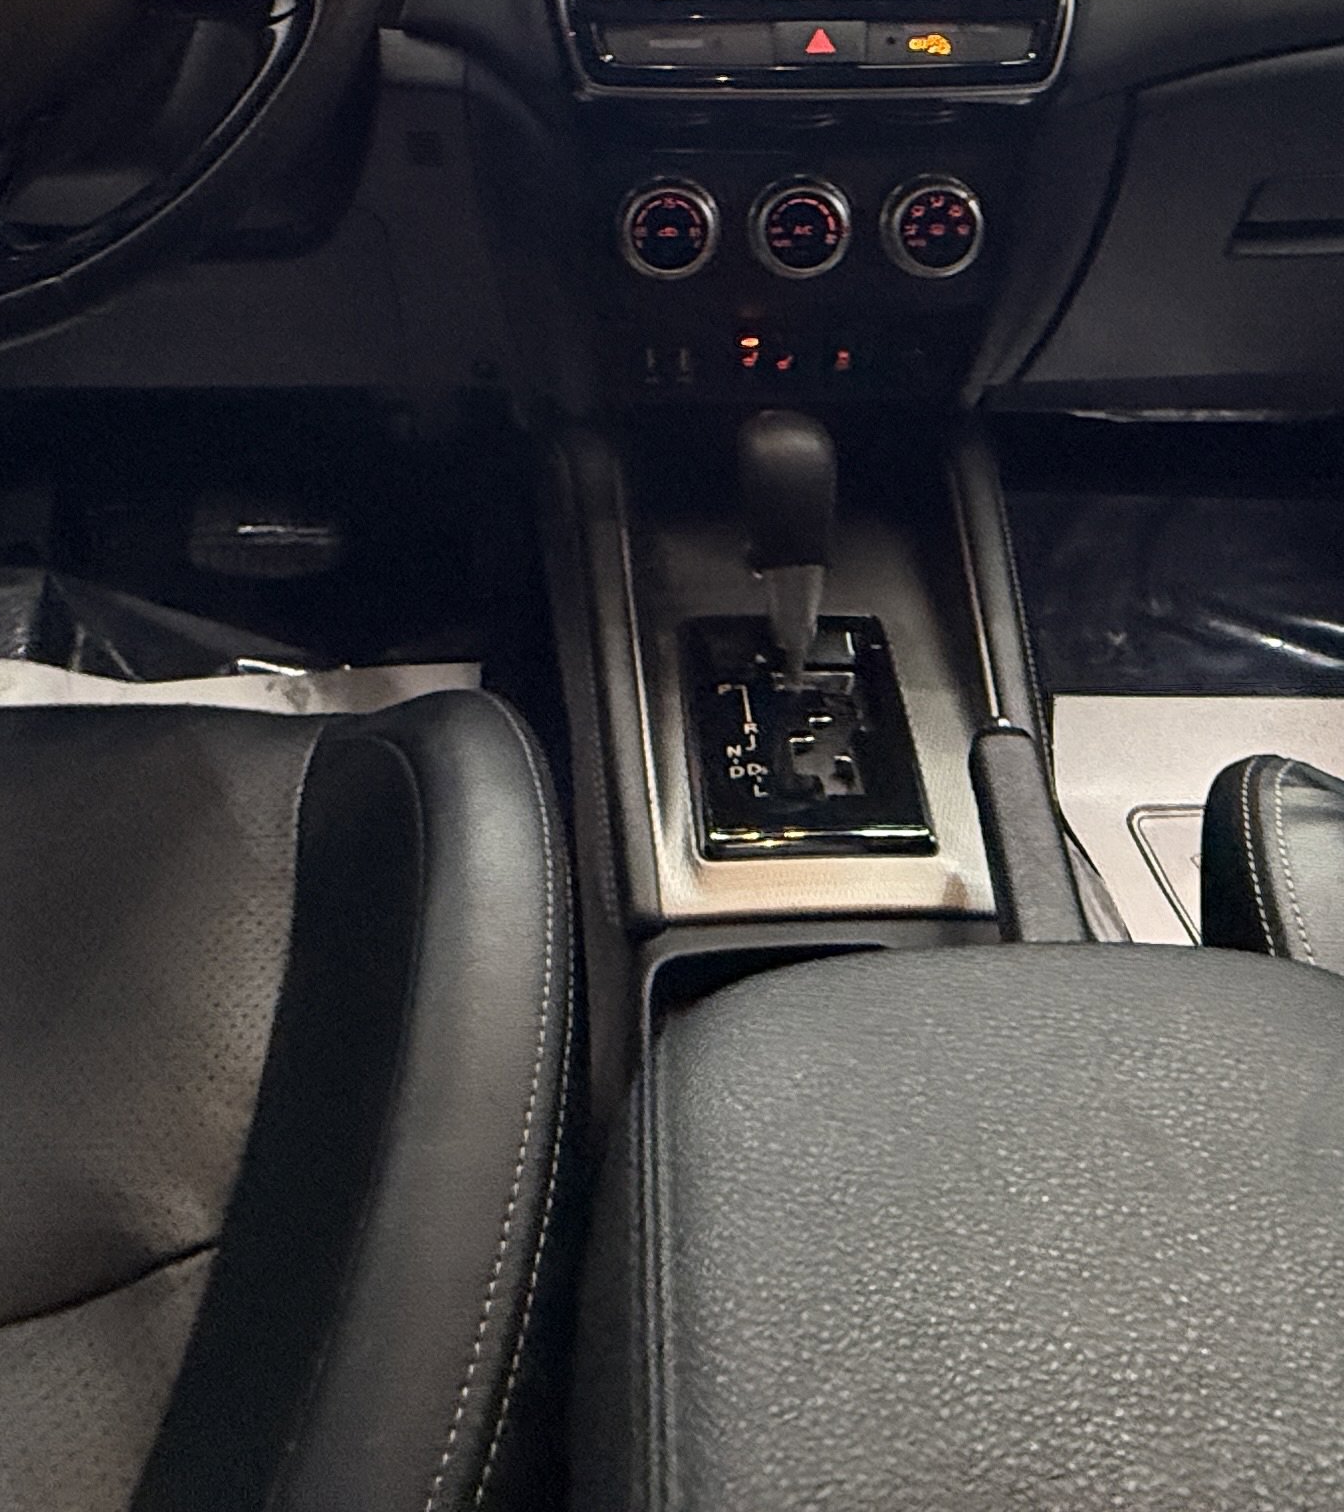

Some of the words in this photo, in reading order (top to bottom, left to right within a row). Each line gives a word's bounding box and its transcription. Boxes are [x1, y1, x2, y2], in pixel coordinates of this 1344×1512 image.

[717, 683, 732, 695] P
[743, 722, 759, 735] R
[726, 744, 742, 758] N
[729, 765, 746, 779] D
[754, 784, 769, 798] L
